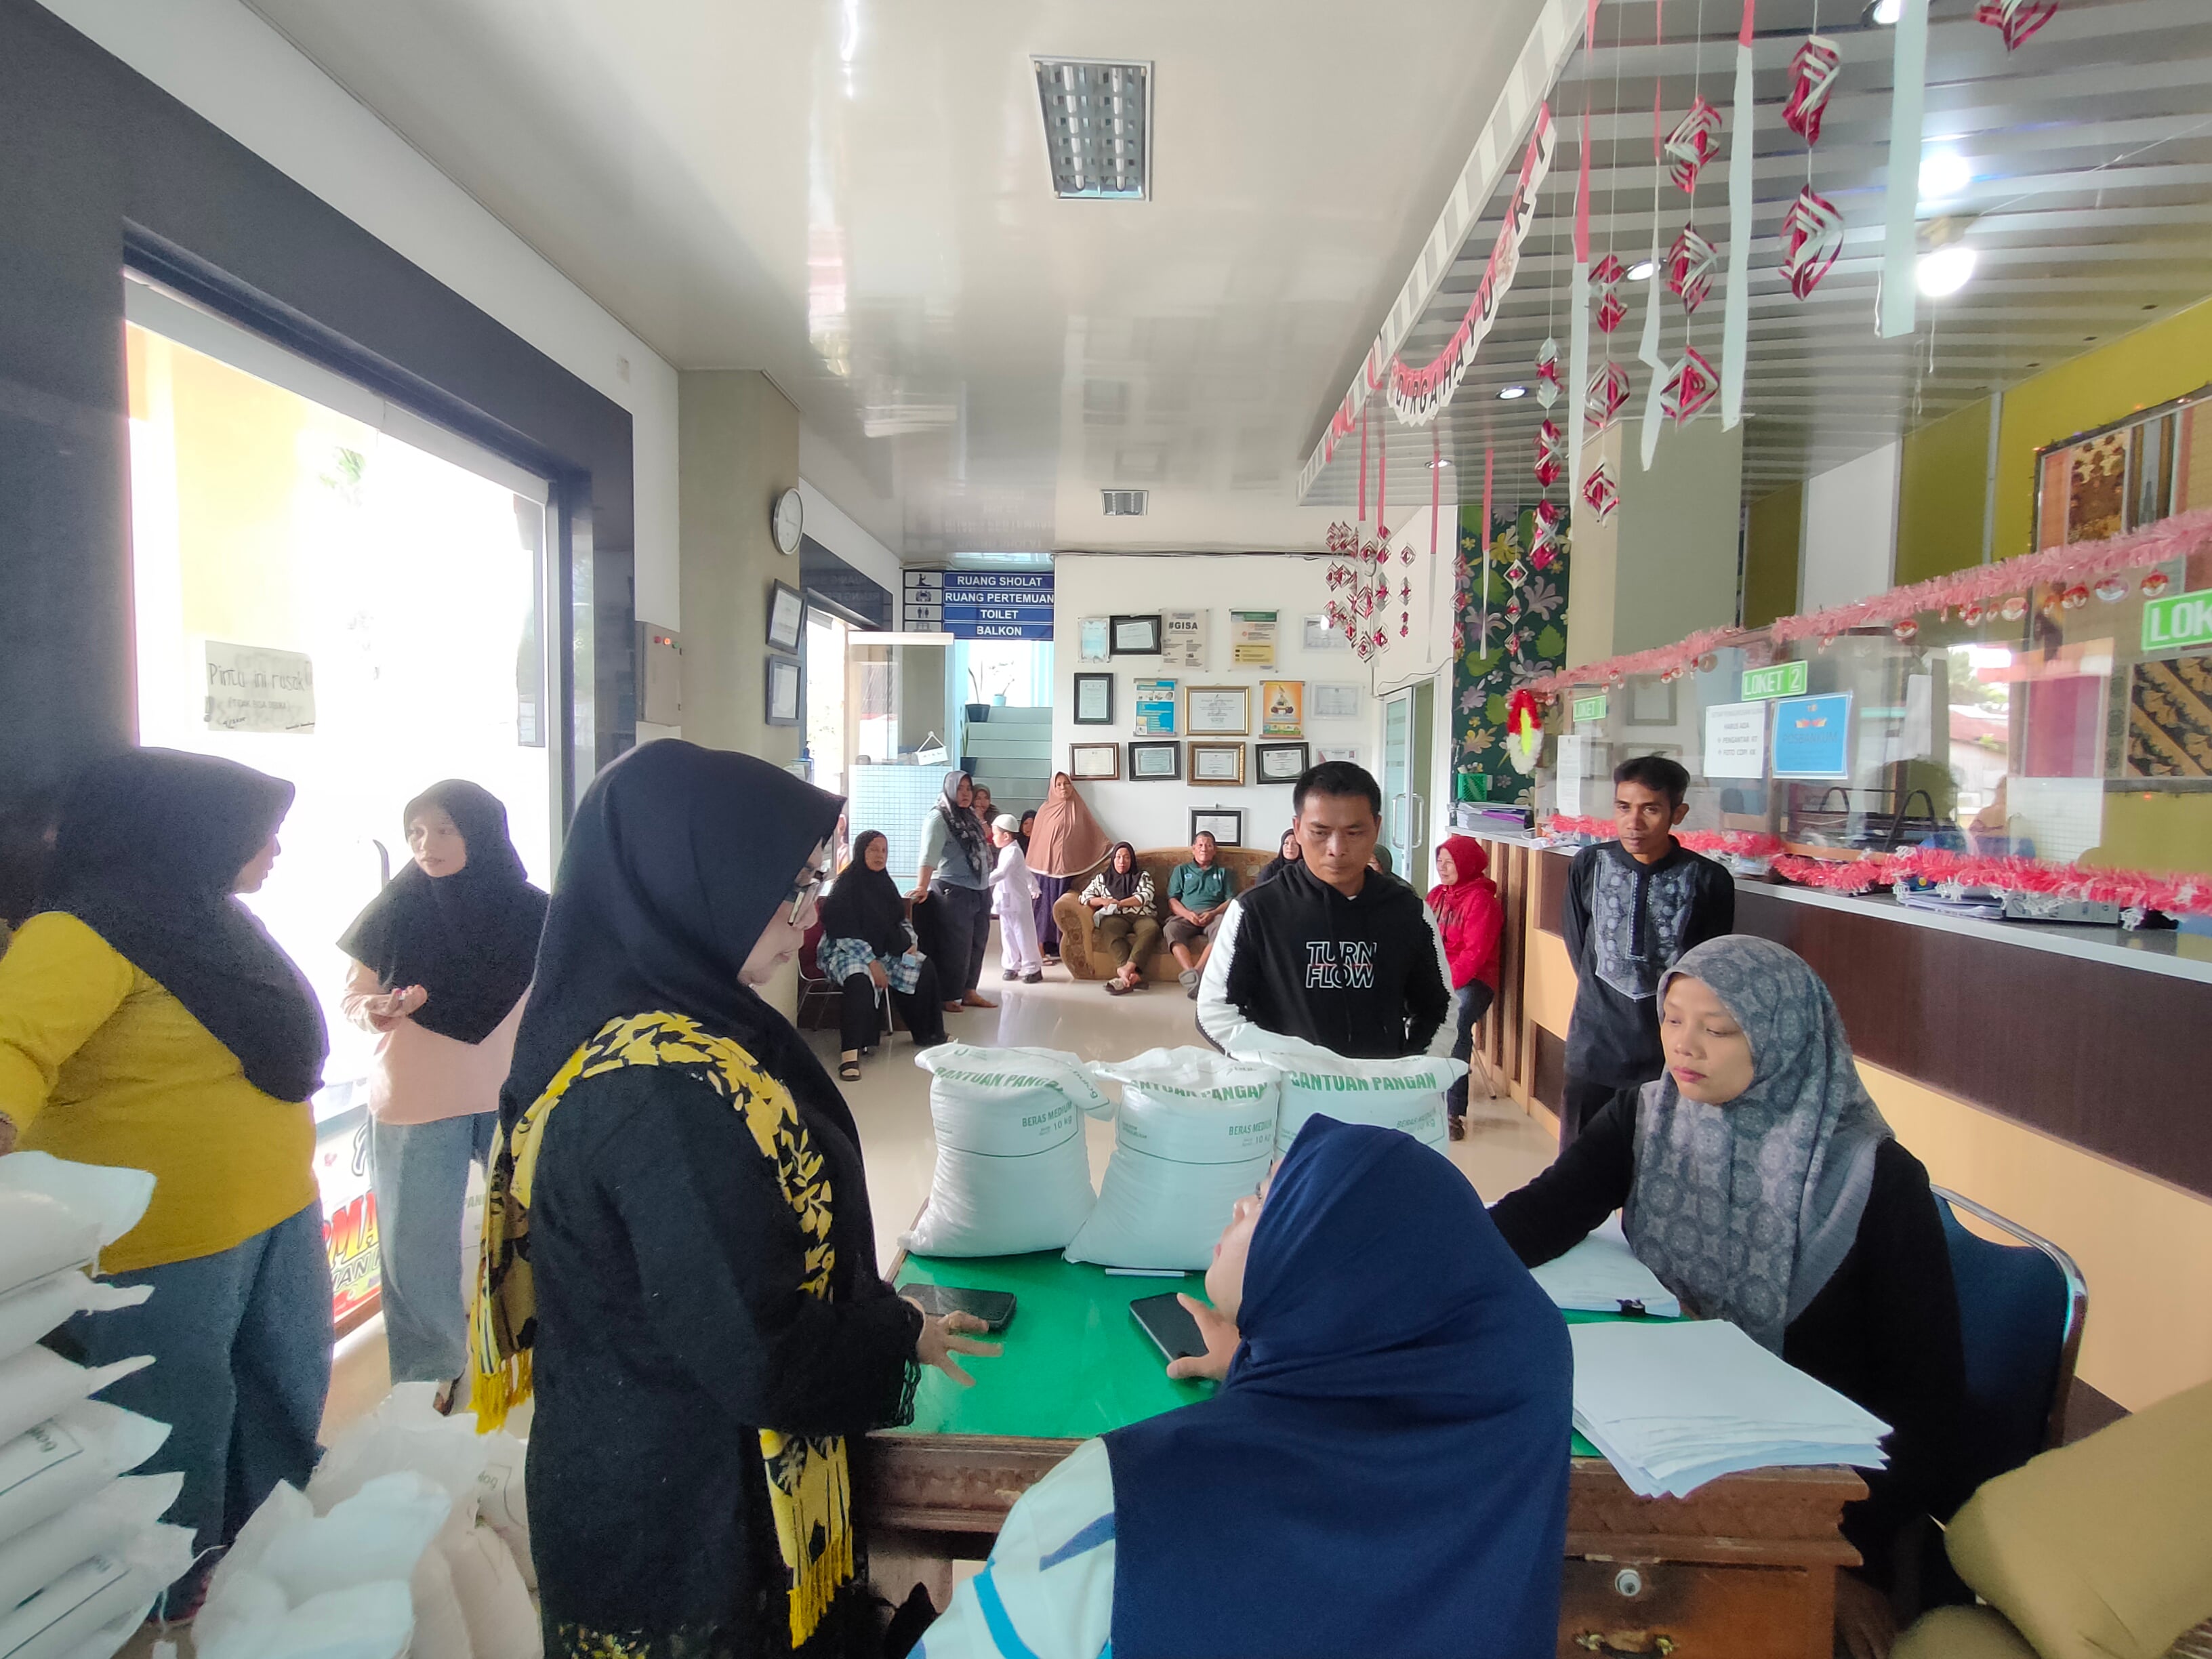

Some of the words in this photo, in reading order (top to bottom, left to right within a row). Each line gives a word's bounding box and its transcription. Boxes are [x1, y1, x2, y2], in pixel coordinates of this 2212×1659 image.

[1395, 276, 1495, 415] DIRGAHAYU
[957, 576, 996, 586] RUANG
[999, 577, 1042, 587] SHOLAT
[945, 592, 984, 602] RUANG
[987, 594, 1054, 604] PERTEMUAN
[980, 609, 1019, 619] TOILET
[977, 626, 1022, 636] BALKON
[1168, 621, 1198, 630] #GISA
[1744, 670, 1785, 695] LOKET
[1790, 666, 1801, 691] 2
[1306, 941, 1377, 966] TURN
[1305, 964, 1375, 989] FLOW
[1371, 1072, 1437, 1090] PANGAN
[1022, 1113, 1046, 1127] BERAS
[1048, 1101, 1073, 1120] MEDIUM
[1054, 1120, 1063, 1130] 10
[1064, 1115, 1072, 1126] kg
[1229, 1124, 1252, 1136] BERAS
